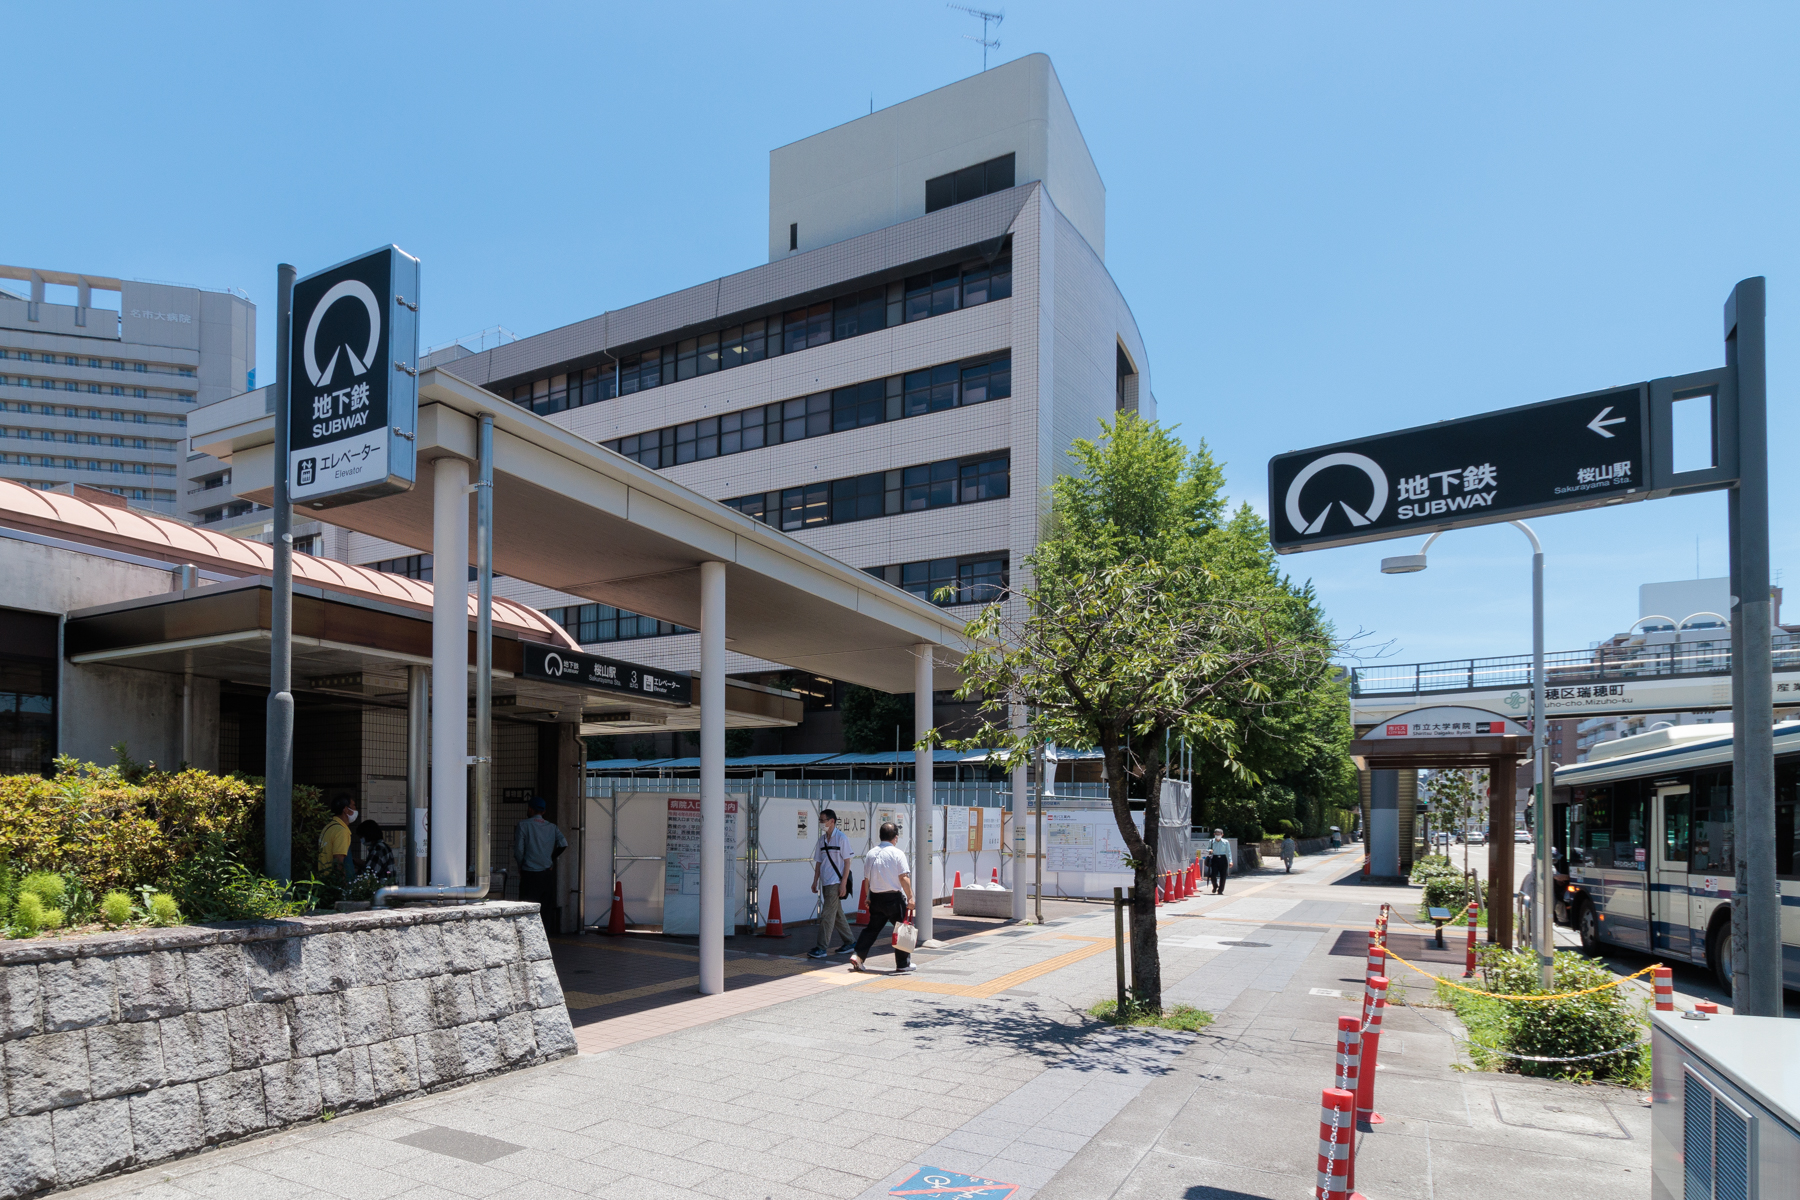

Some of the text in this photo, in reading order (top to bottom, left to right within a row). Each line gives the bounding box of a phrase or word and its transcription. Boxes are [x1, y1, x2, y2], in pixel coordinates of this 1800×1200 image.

[130, 308, 192, 324] 名市大病院
[312, 381, 370, 420] 地下鉄
[312, 409, 370, 439] SUBWAY
[320, 444, 381, 471] エレベーター
[334, 466, 363, 479] Elevator
[1576, 460, 1632, 484] 桜山駅
[1397, 462, 1498, 503] 地下鉄
[1554, 476, 1633, 496] Sakurayama Sta.
[1397, 490, 1498, 520] SUBWAY
[563, 660, 579, 669] 地下鉄
[594, 663, 616, 679] 桜山駅
[630, 670, 638, 684] 3
[654, 677, 681, 689] エレベーター
[1531, 684, 1625, 700] 穂区瑞穂町
[1412, 722, 1472, 731] 市立大学病院
